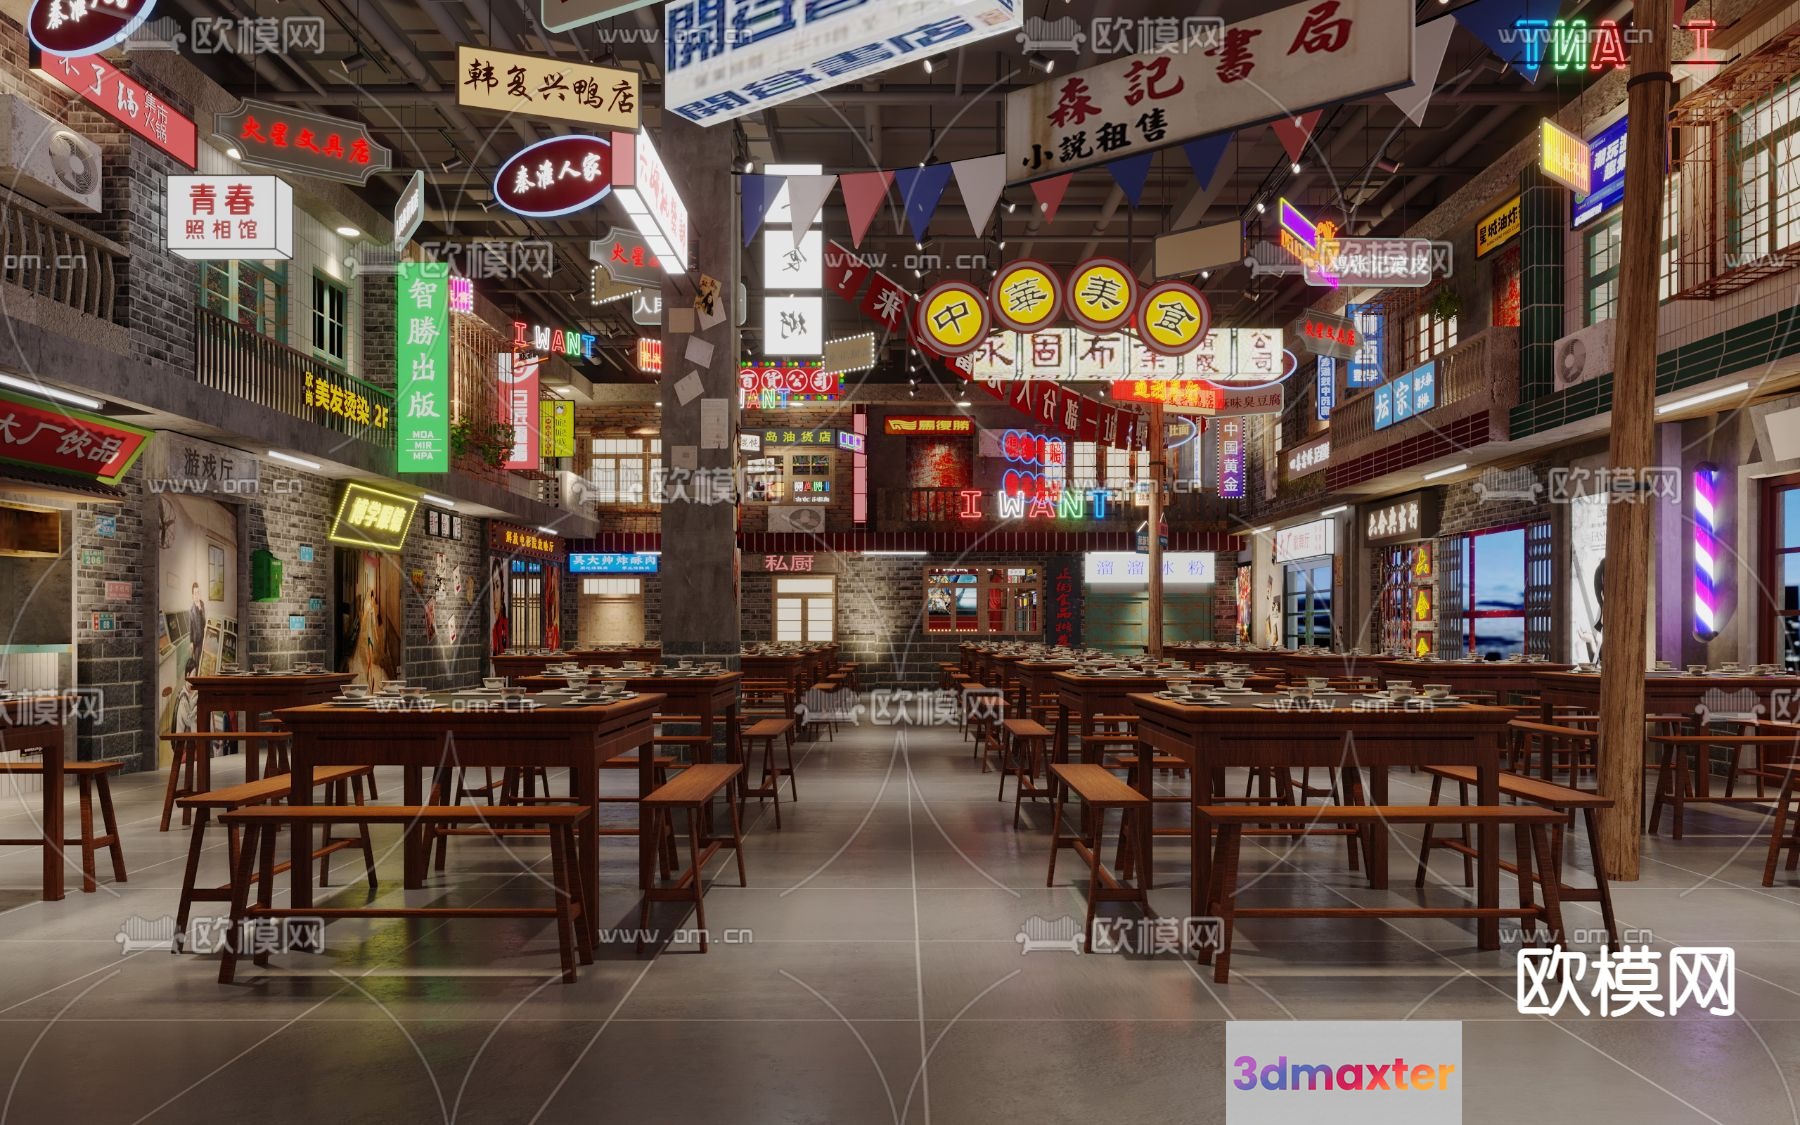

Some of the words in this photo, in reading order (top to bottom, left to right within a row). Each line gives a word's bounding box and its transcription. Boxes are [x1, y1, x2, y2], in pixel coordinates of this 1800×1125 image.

[1047, 0, 1354, 129] 森記書局
[463, 57, 635, 115] 韩复兴鸭店
[240, 115, 372, 165] 火星文具店
[512, 152, 602, 194] 秦淮人家
[189, 183, 255, 216] 青春
[185, 219, 258, 240] 照相馆
[1480, 204, 1520, 245] 星城油炸
[406, 277, 441, 419] 智勝出版
[514, 321, 527, 346] I
[535, 325, 596, 358] WANT
[315, 379, 370, 424] 美发烫染
[374, 403, 390, 430] 2F
[412, 430, 434, 440] MOA
[414, 440, 432, 450] MIR
[184, 447, 234, 482] 游戏厅
[412, 451, 434, 460] MPA
[960, 490, 983, 519] I
[998, 489, 1113, 519] WANT
[765, 554, 815, 572] 私厨
